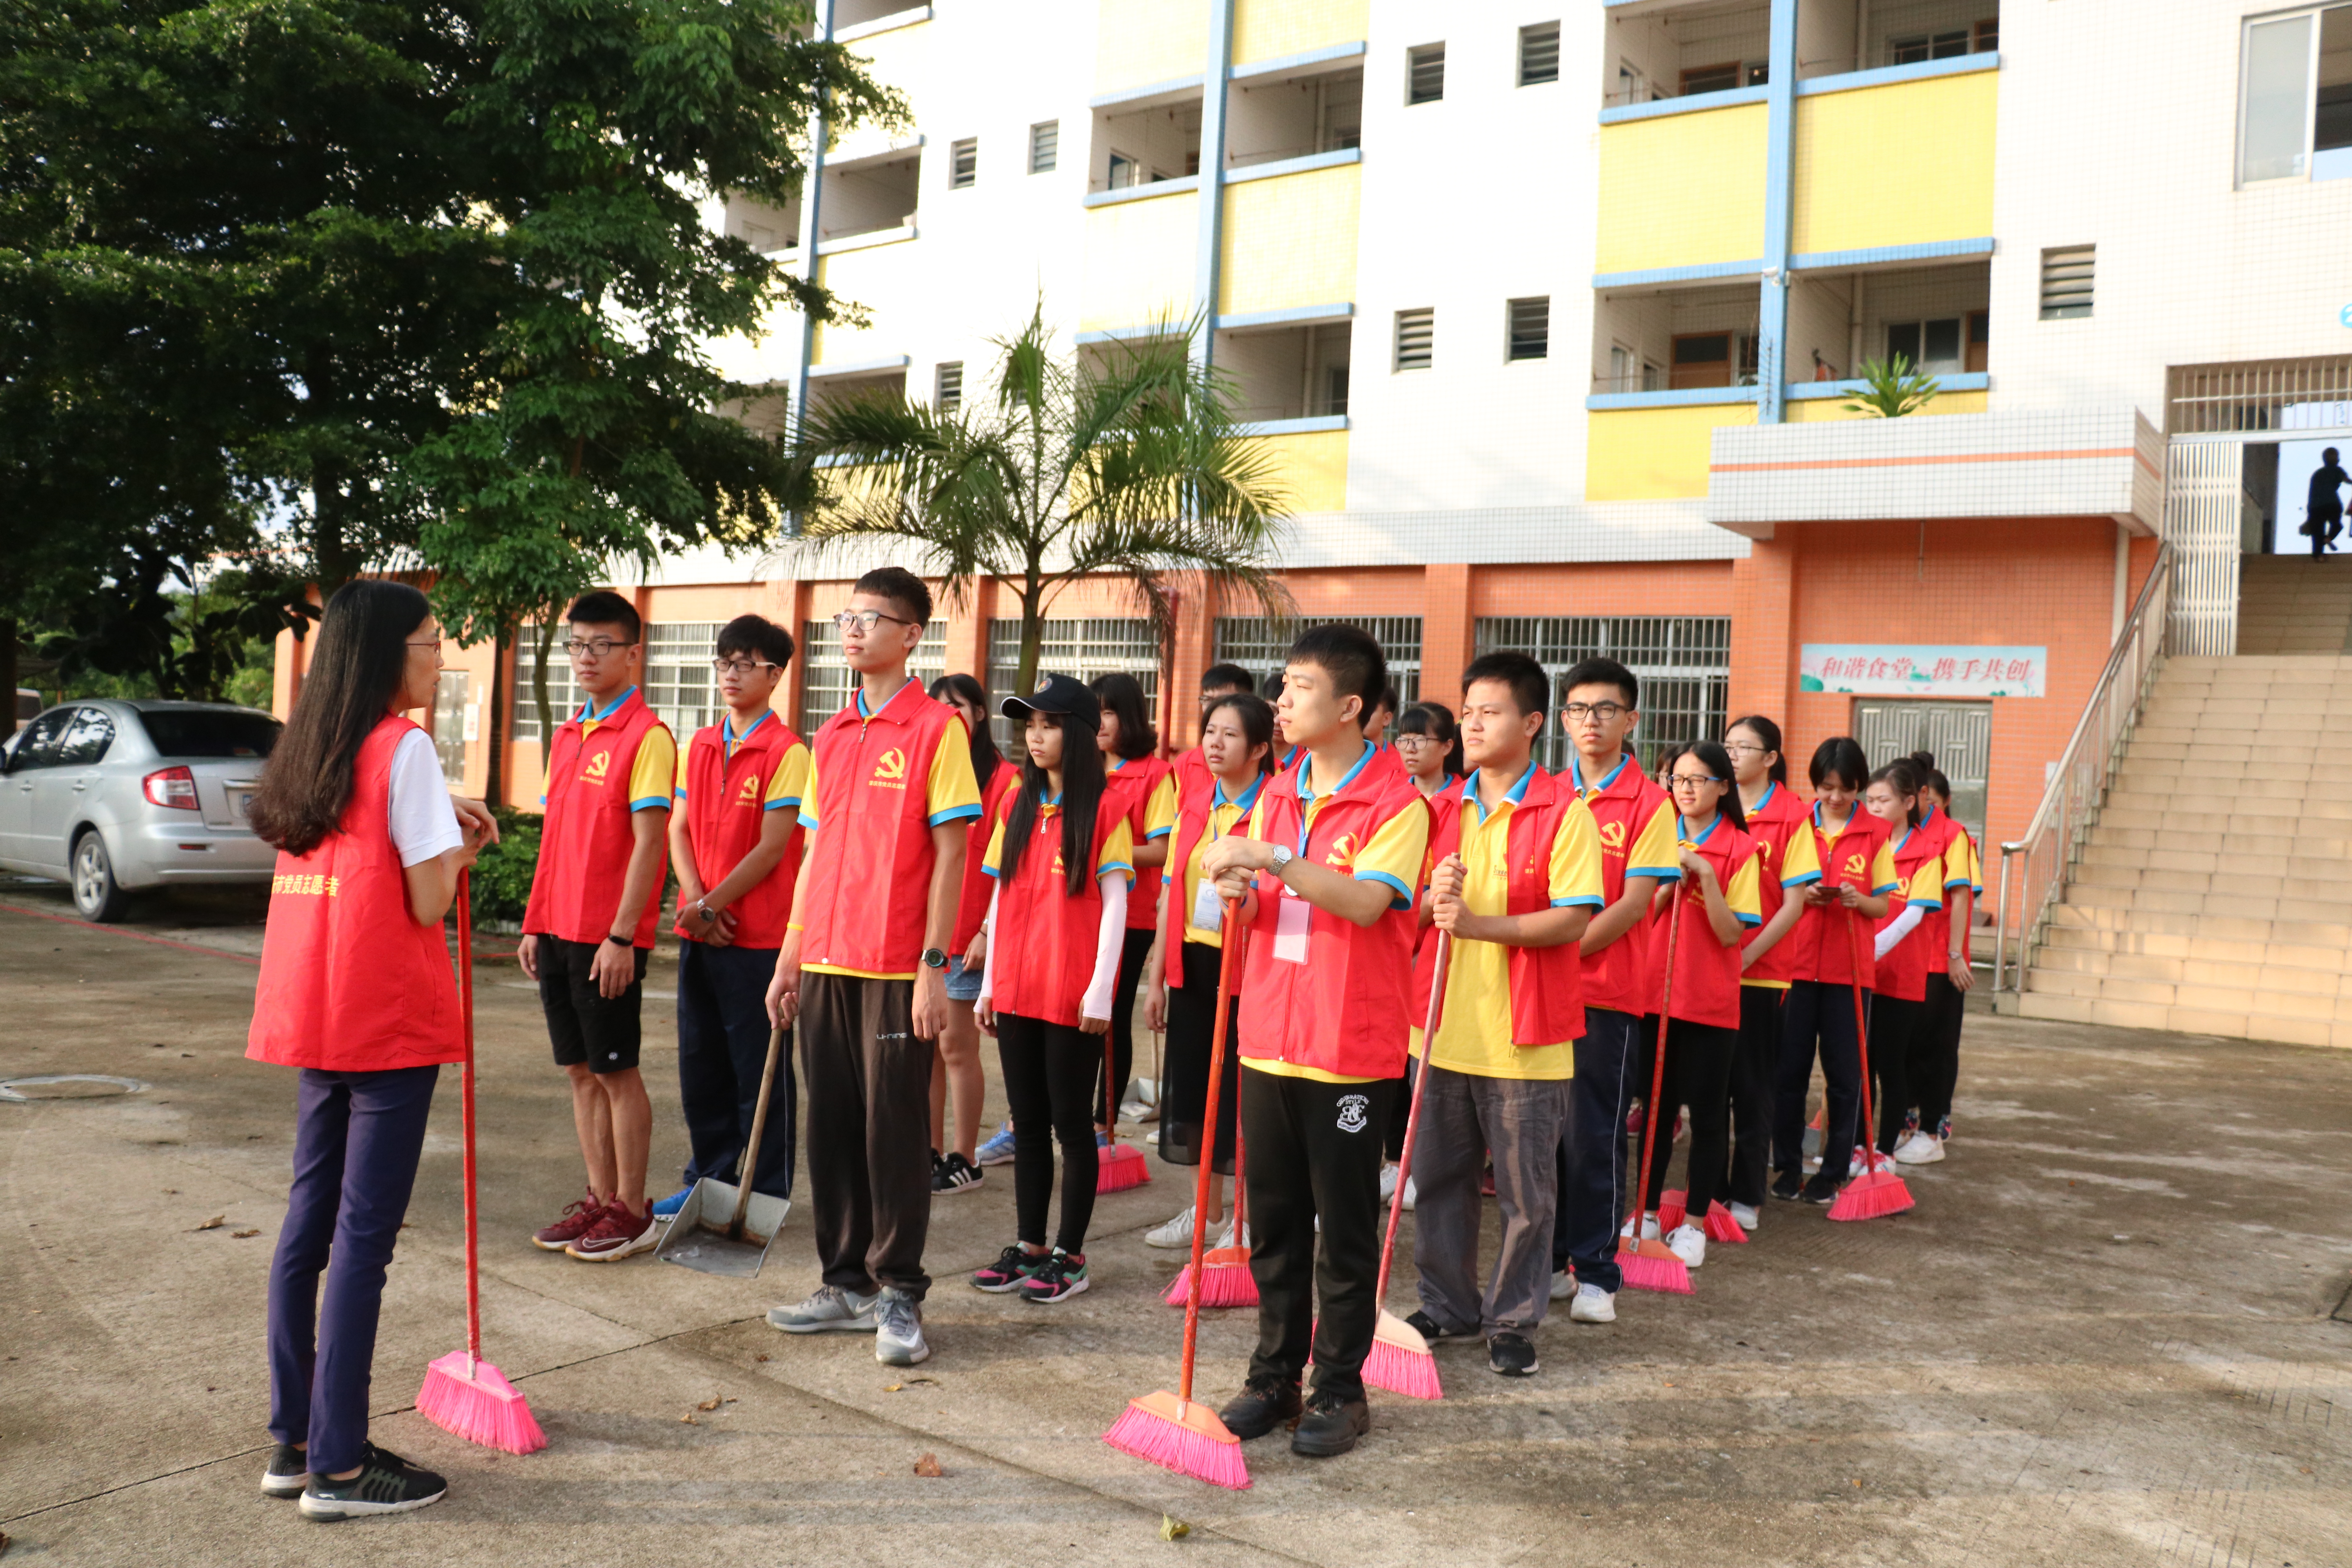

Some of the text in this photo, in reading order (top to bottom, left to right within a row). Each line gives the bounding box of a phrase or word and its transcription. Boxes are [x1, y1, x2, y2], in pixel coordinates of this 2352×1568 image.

[1820, 656, 2031, 681] 和谐食堂 携手共创
